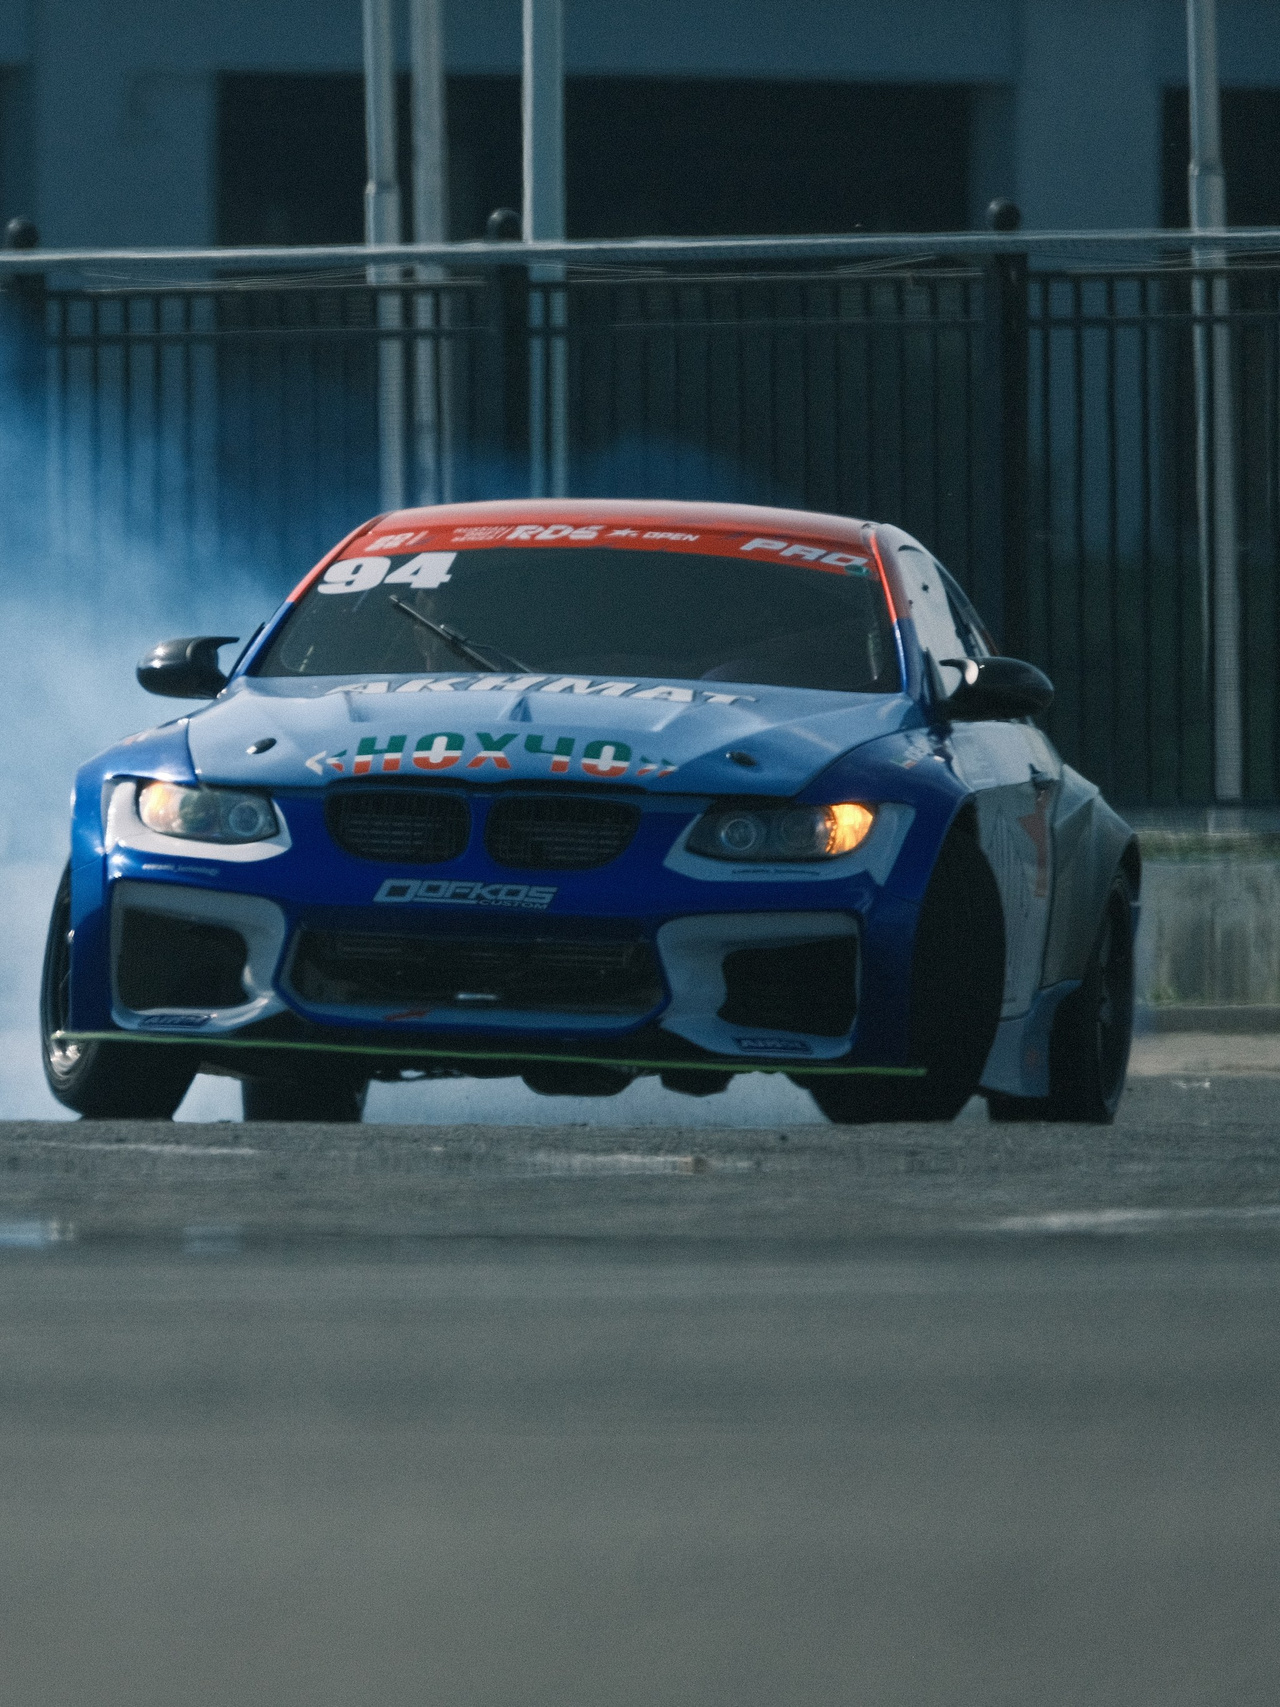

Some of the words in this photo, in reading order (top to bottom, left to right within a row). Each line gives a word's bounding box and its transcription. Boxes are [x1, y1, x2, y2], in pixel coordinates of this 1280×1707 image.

[642, 531, 700, 542] OPEN
[317, 552, 458, 595] 94
[325, 673, 757, 705] AKHMAT
